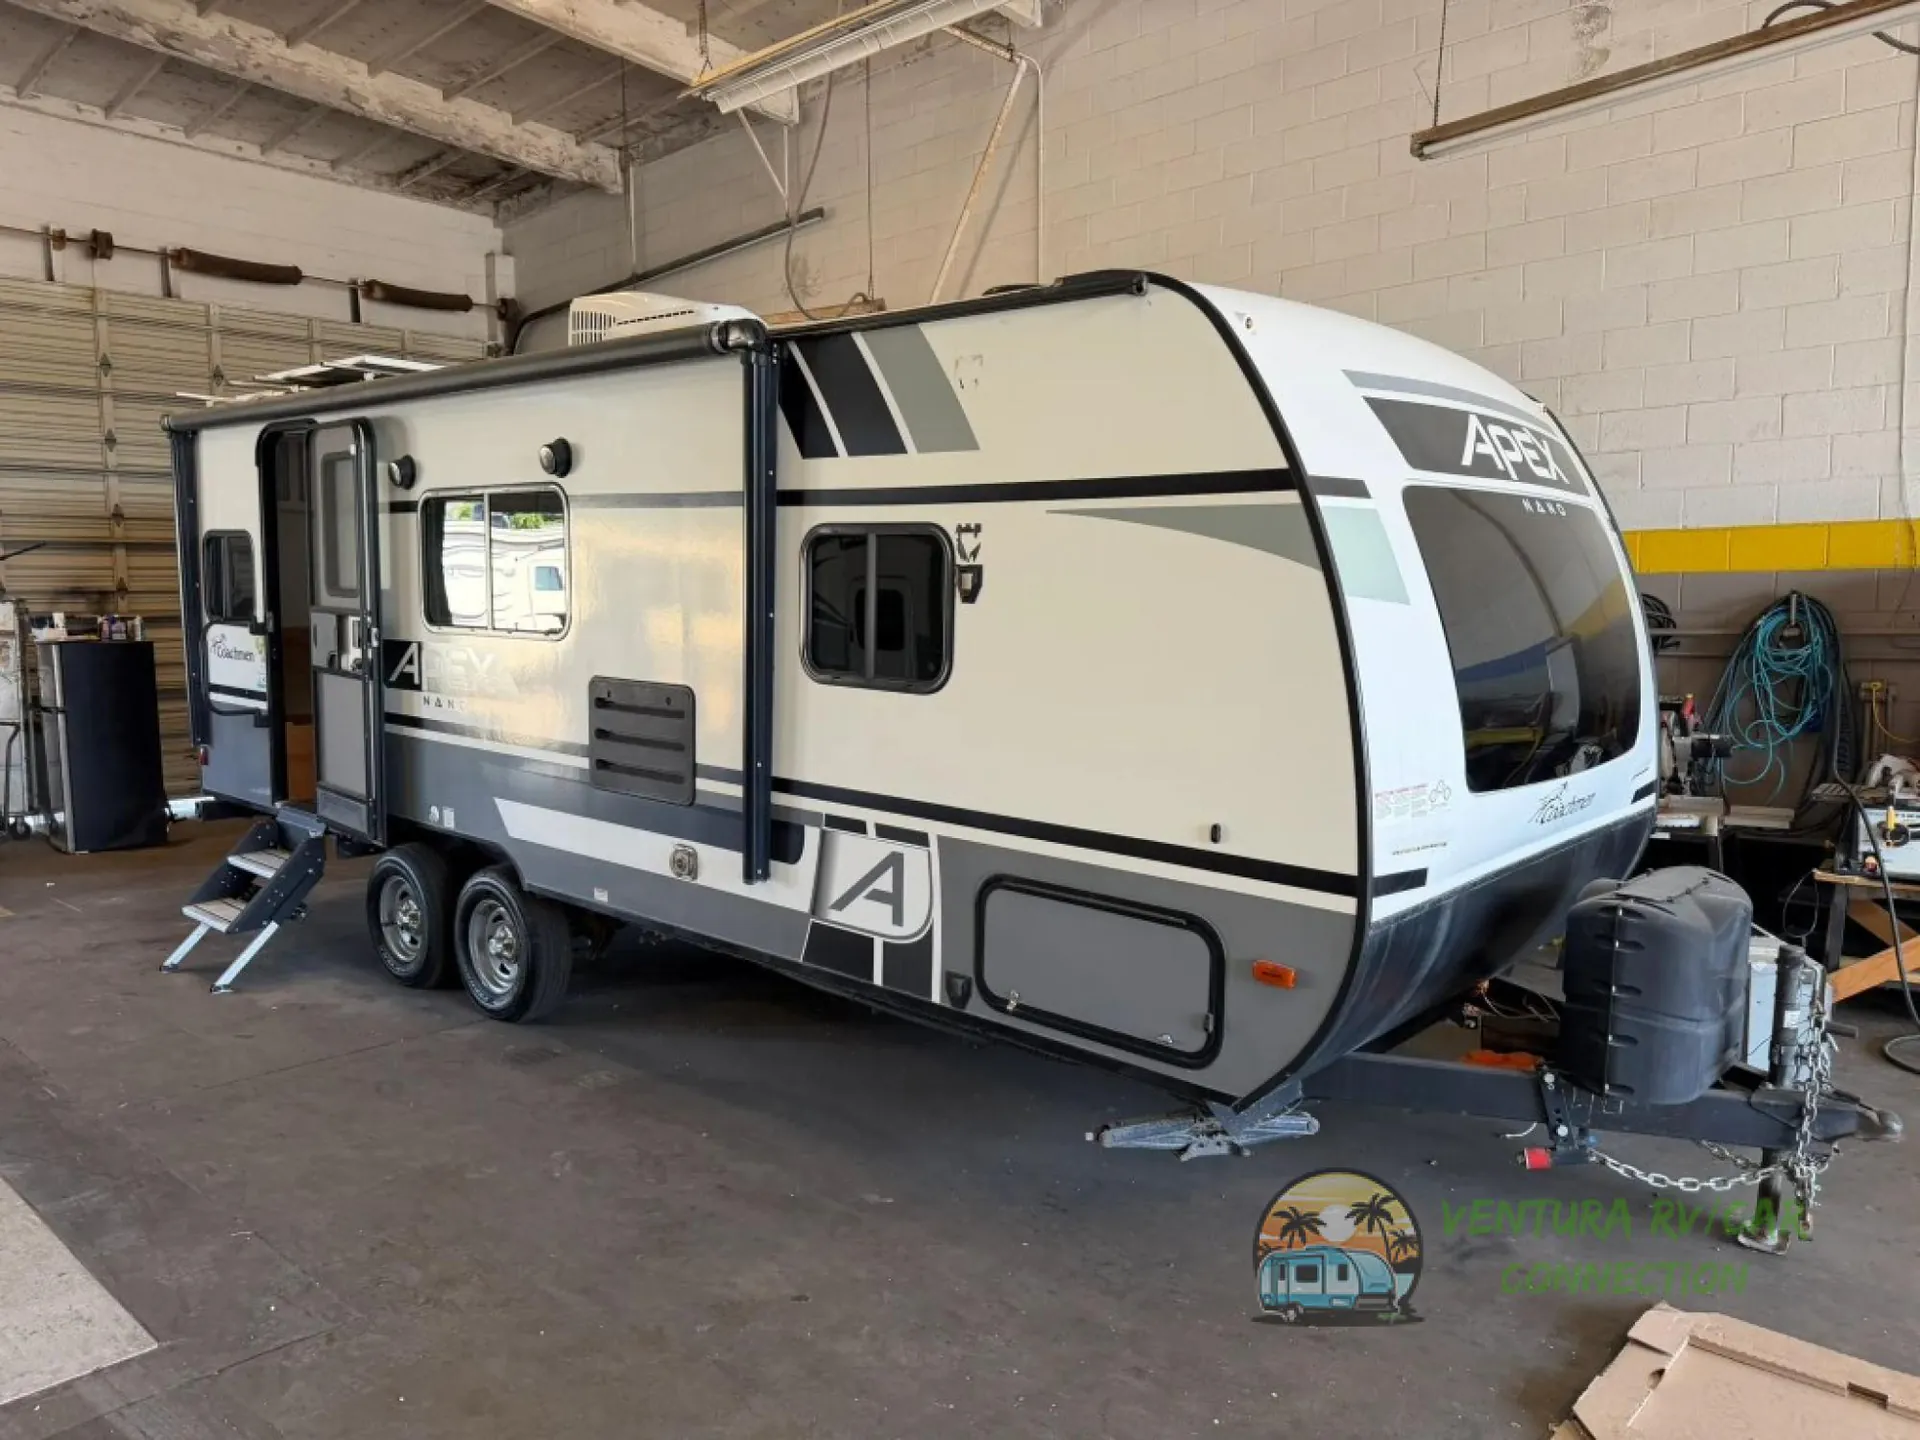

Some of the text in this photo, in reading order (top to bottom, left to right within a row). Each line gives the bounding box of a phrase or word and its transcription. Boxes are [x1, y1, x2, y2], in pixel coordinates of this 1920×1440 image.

[1460, 413, 1570, 485] APEX
[1522, 497, 1567, 517] NANO
[217, 644, 255, 662] Coachmen
[828, 850, 905, 928] A
